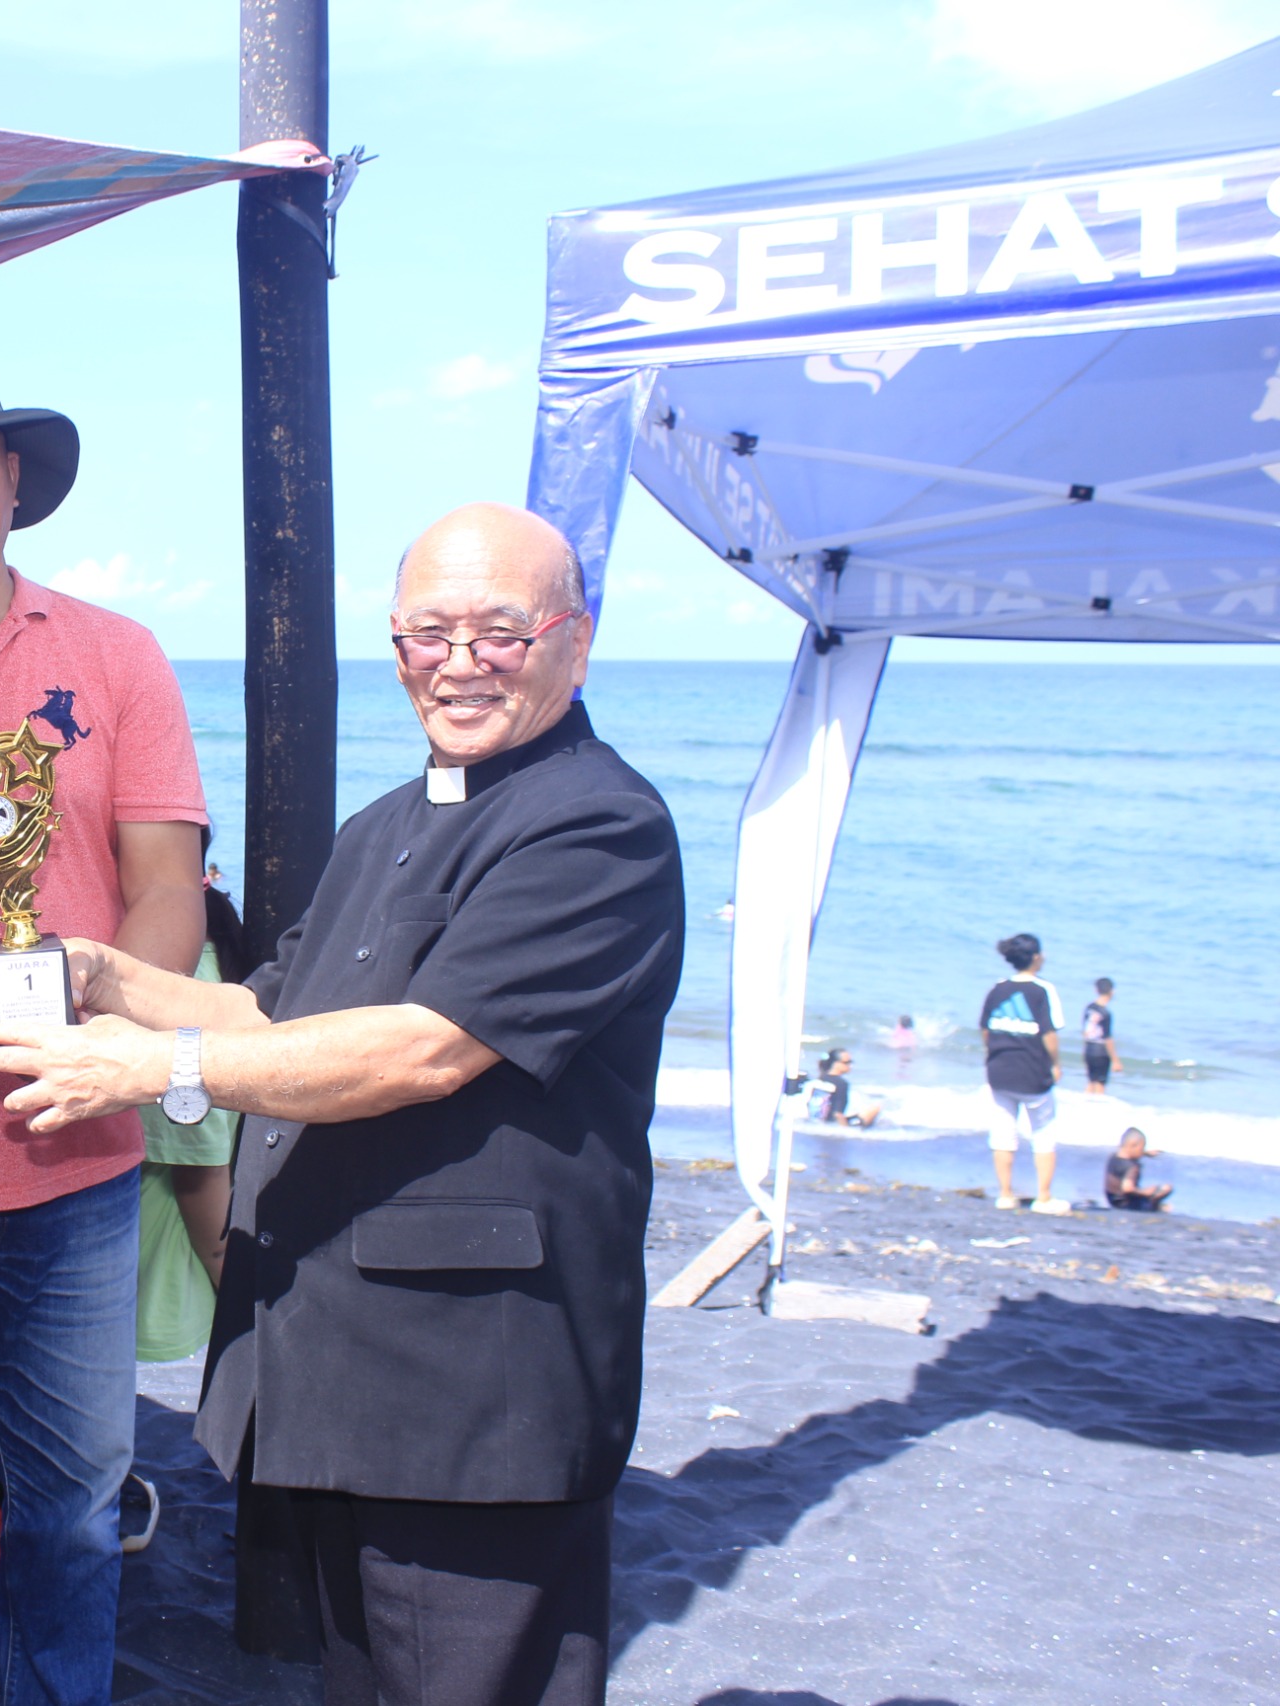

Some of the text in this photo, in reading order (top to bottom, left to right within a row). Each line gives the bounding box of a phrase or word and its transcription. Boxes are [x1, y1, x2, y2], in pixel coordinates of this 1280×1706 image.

[618, 177, 1224, 325] SEHAT
[7, 960, 50, 971] JUARA
[23, 973, 33, 991] 1
